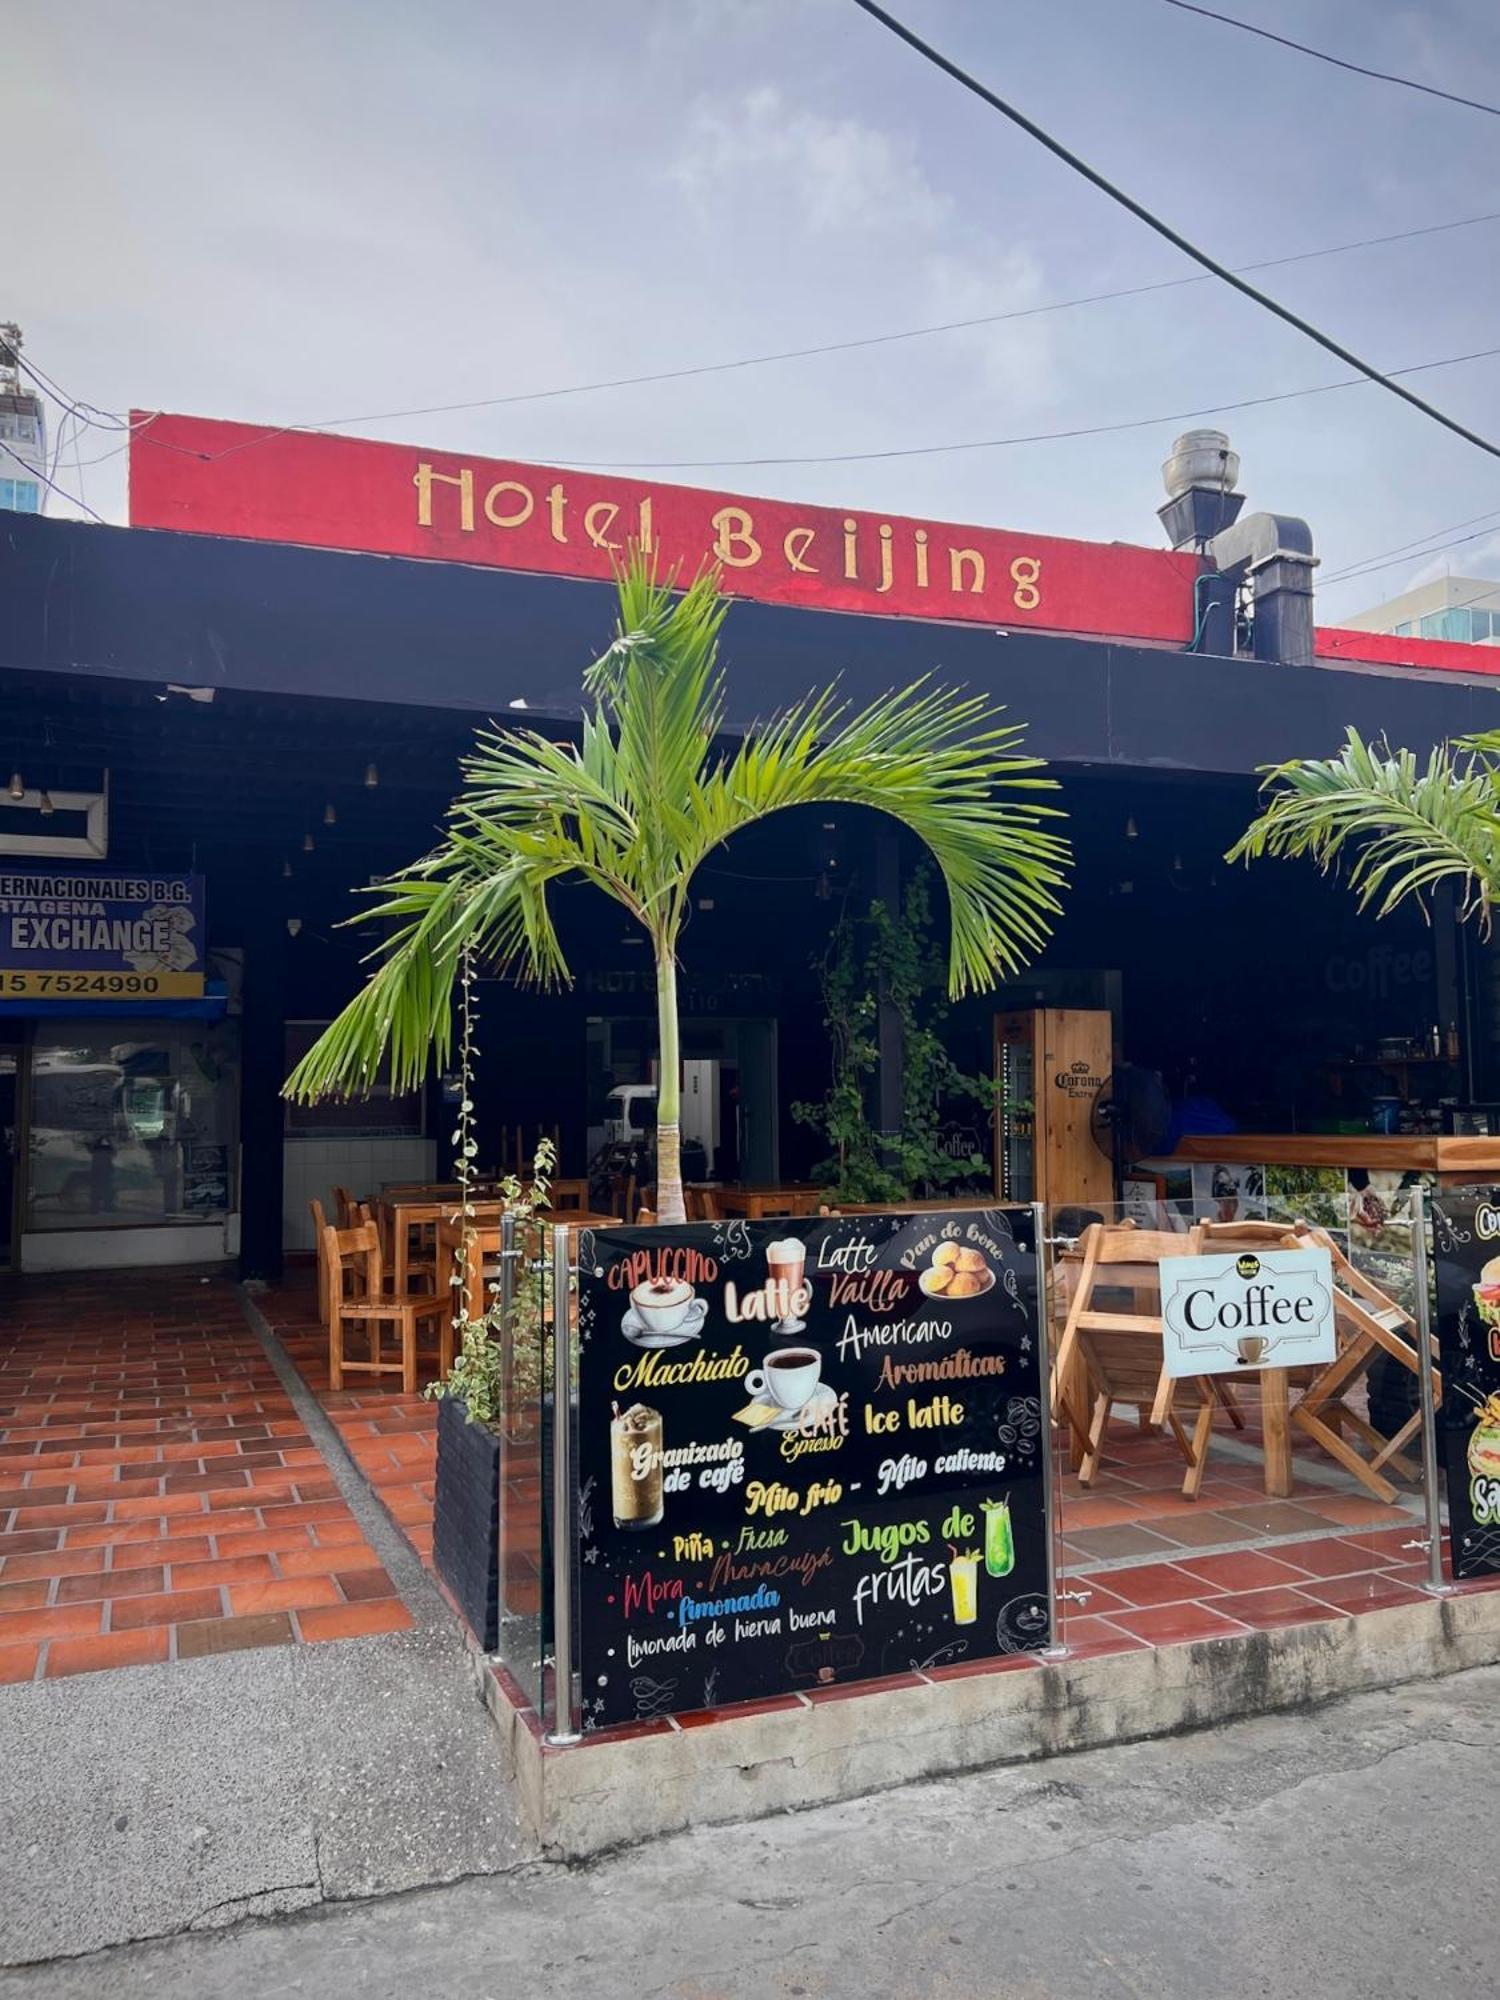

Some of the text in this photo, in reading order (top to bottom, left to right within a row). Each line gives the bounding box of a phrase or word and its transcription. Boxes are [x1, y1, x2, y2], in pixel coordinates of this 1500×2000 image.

[413, 463, 1041, 610] Hotel Beijing
[153, 882, 193, 901] B.G.
[11, 917, 171, 952] EXCHANGE
[37, 975, 159, 993] 7524990
[1325, 944, 1432, 999] Coffee
[1055, 1072, 1103, 1089] Corona
[818, 1234, 879, 1274] Latte
[724, 1279, 811, 1324] Latte
[1184, 1284, 1315, 1332] Coffee
[835, 1313, 953, 1363] Americano
[613, 1344, 750, 1392] Macchiato
[864, 1395, 965, 1435] Ice latte
[629, 1436, 744, 1481] Granizado
[663, 1456, 745, 1493] de café
[745, 1480, 799, 1517] Milo
[877, 1453, 928, 1495] Milo
[934, 1449, 1006, 1474] caliente
[673, 1526, 789, 1562] Piña Fresa
[840, 1505, 975, 1564] Jugos de
[624, 1571, 684, 1619] Mora
[853, 1551, 946, 1626] frutas
[705, 1620, 727, 1648] de
[735, 1617, 782, 1642] hierva
[789, 1607, 837, 1631] buena
